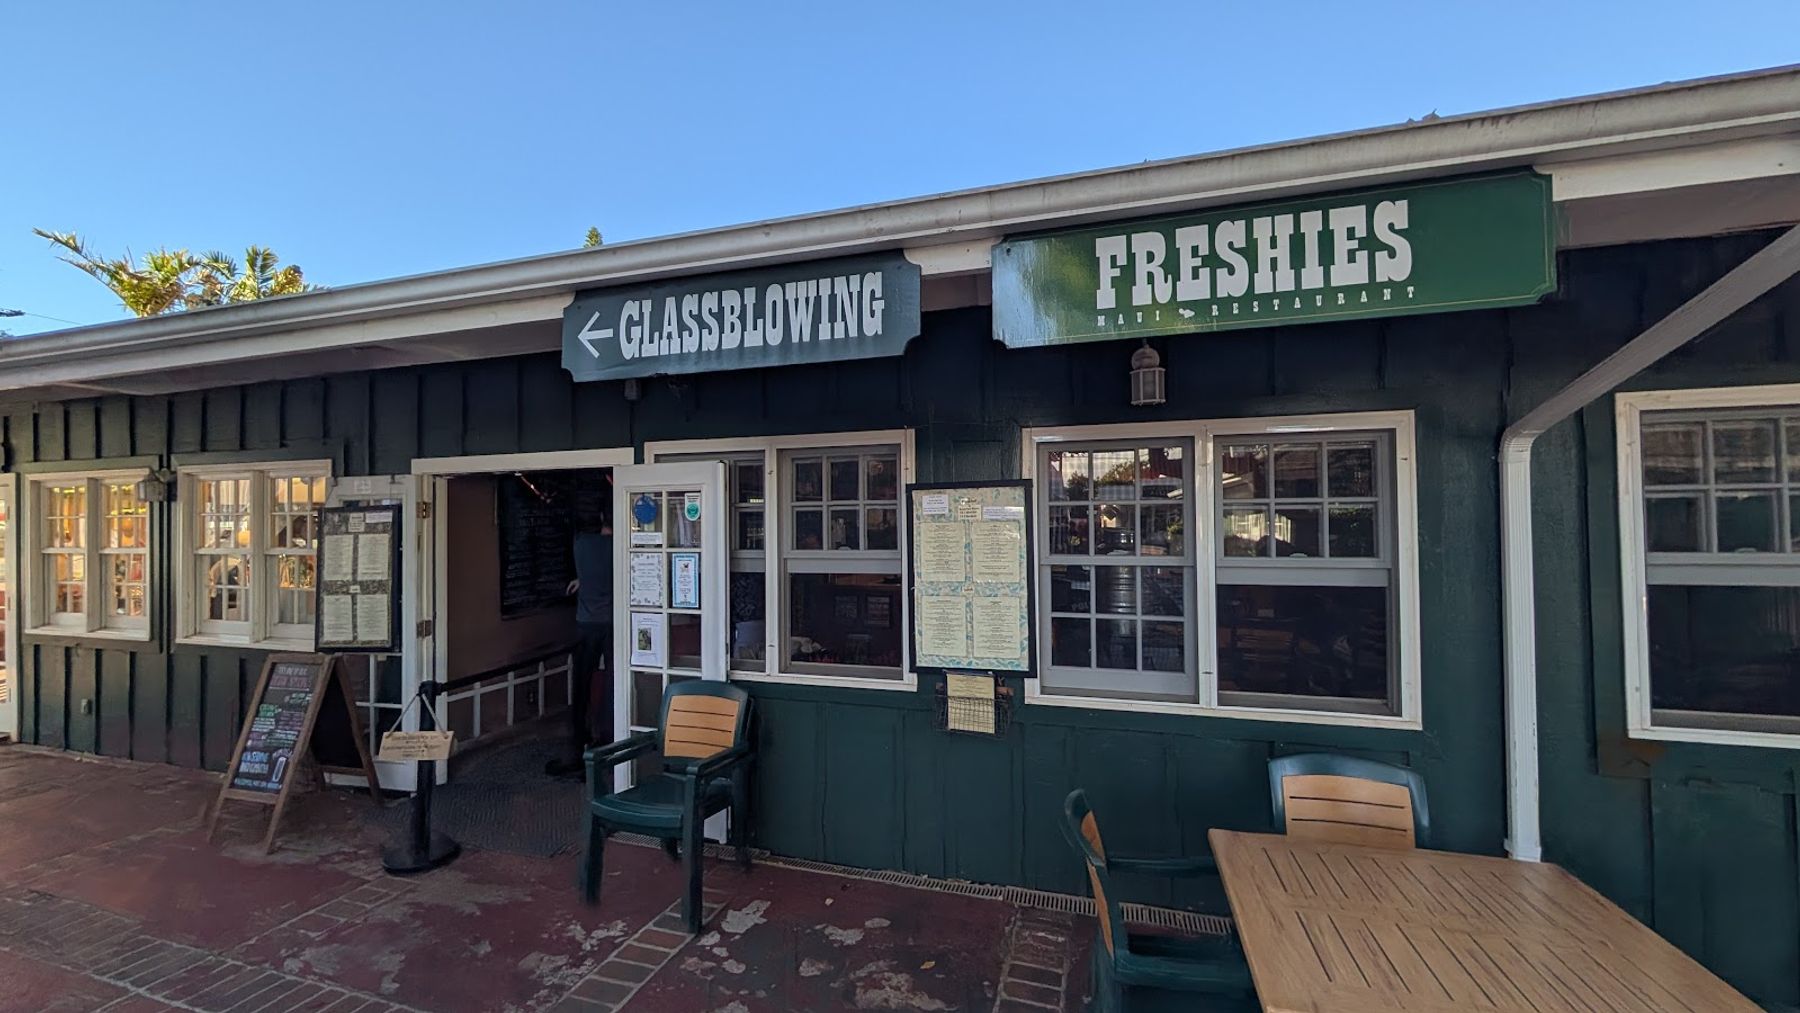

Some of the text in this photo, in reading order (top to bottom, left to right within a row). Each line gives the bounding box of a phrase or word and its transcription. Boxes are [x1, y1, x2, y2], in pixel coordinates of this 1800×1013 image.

[1095, 199, 1412, 309] FRESHIES
[620, 271, 885, 360] GLASSBLOWING
[1097, 285, 1415, 327] MAUI RESTAURANT
